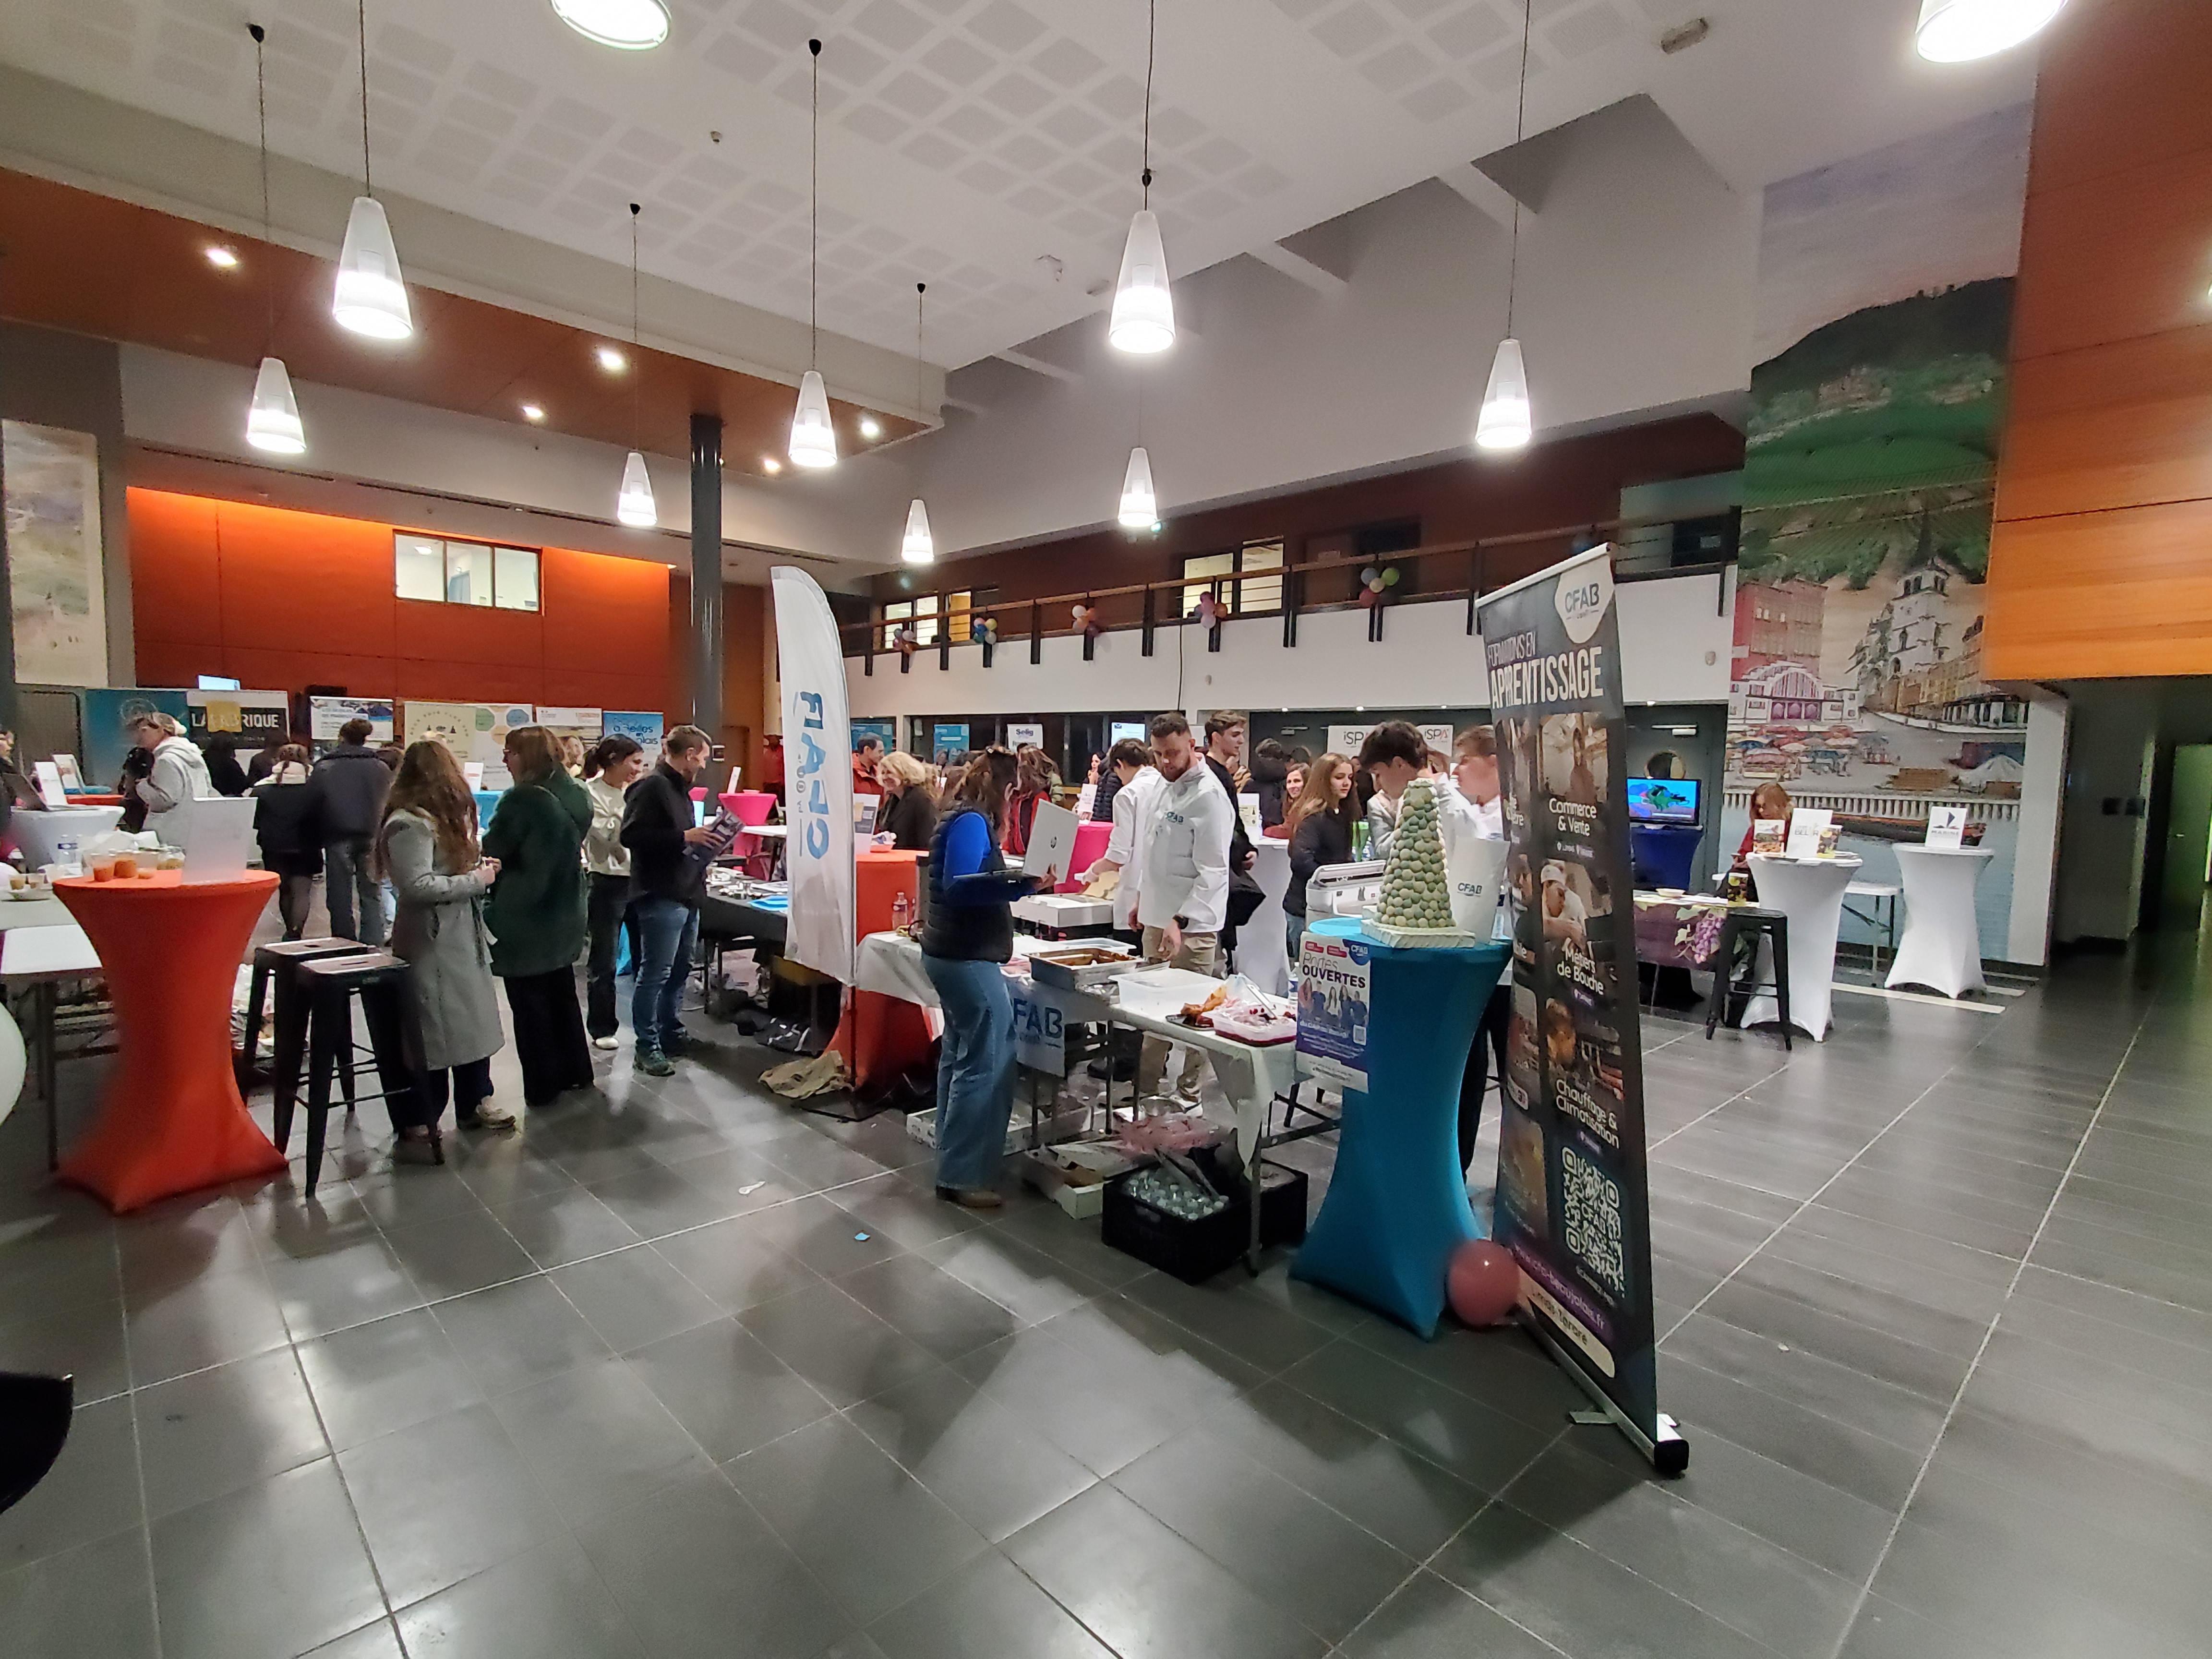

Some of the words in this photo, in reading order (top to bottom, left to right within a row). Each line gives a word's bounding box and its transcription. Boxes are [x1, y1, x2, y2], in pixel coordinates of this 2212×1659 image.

[1565, 583, 1599, 613] CFAB
[1491, 646, 1603, 709] APPRENTISSAGE
[1015, 728, 1034, 736] Selig
[1549, 797, 1597, 819] Commerce
[1558, 816, 1567, 831] &
[1568, 817, 1590, 837] Vente
[1457, 882, 1482, 894] CFAB
[1351, 944, 1368, 955] CFAB
[1565, 947, 1596, 974] Métiers
[1302, 964, 1366, 988] OUVERTES
[1557, 961, 1572, 978] de
[1573, 965, 1604, 995] Bouche
[1010, 998, 1062, 1039] FAB
[1556, 1079, 1607, 1123] Chauffage
[1608, 1112, 1618, 1131] &
[1556, 1094, 1620, 1149] Climatisation
